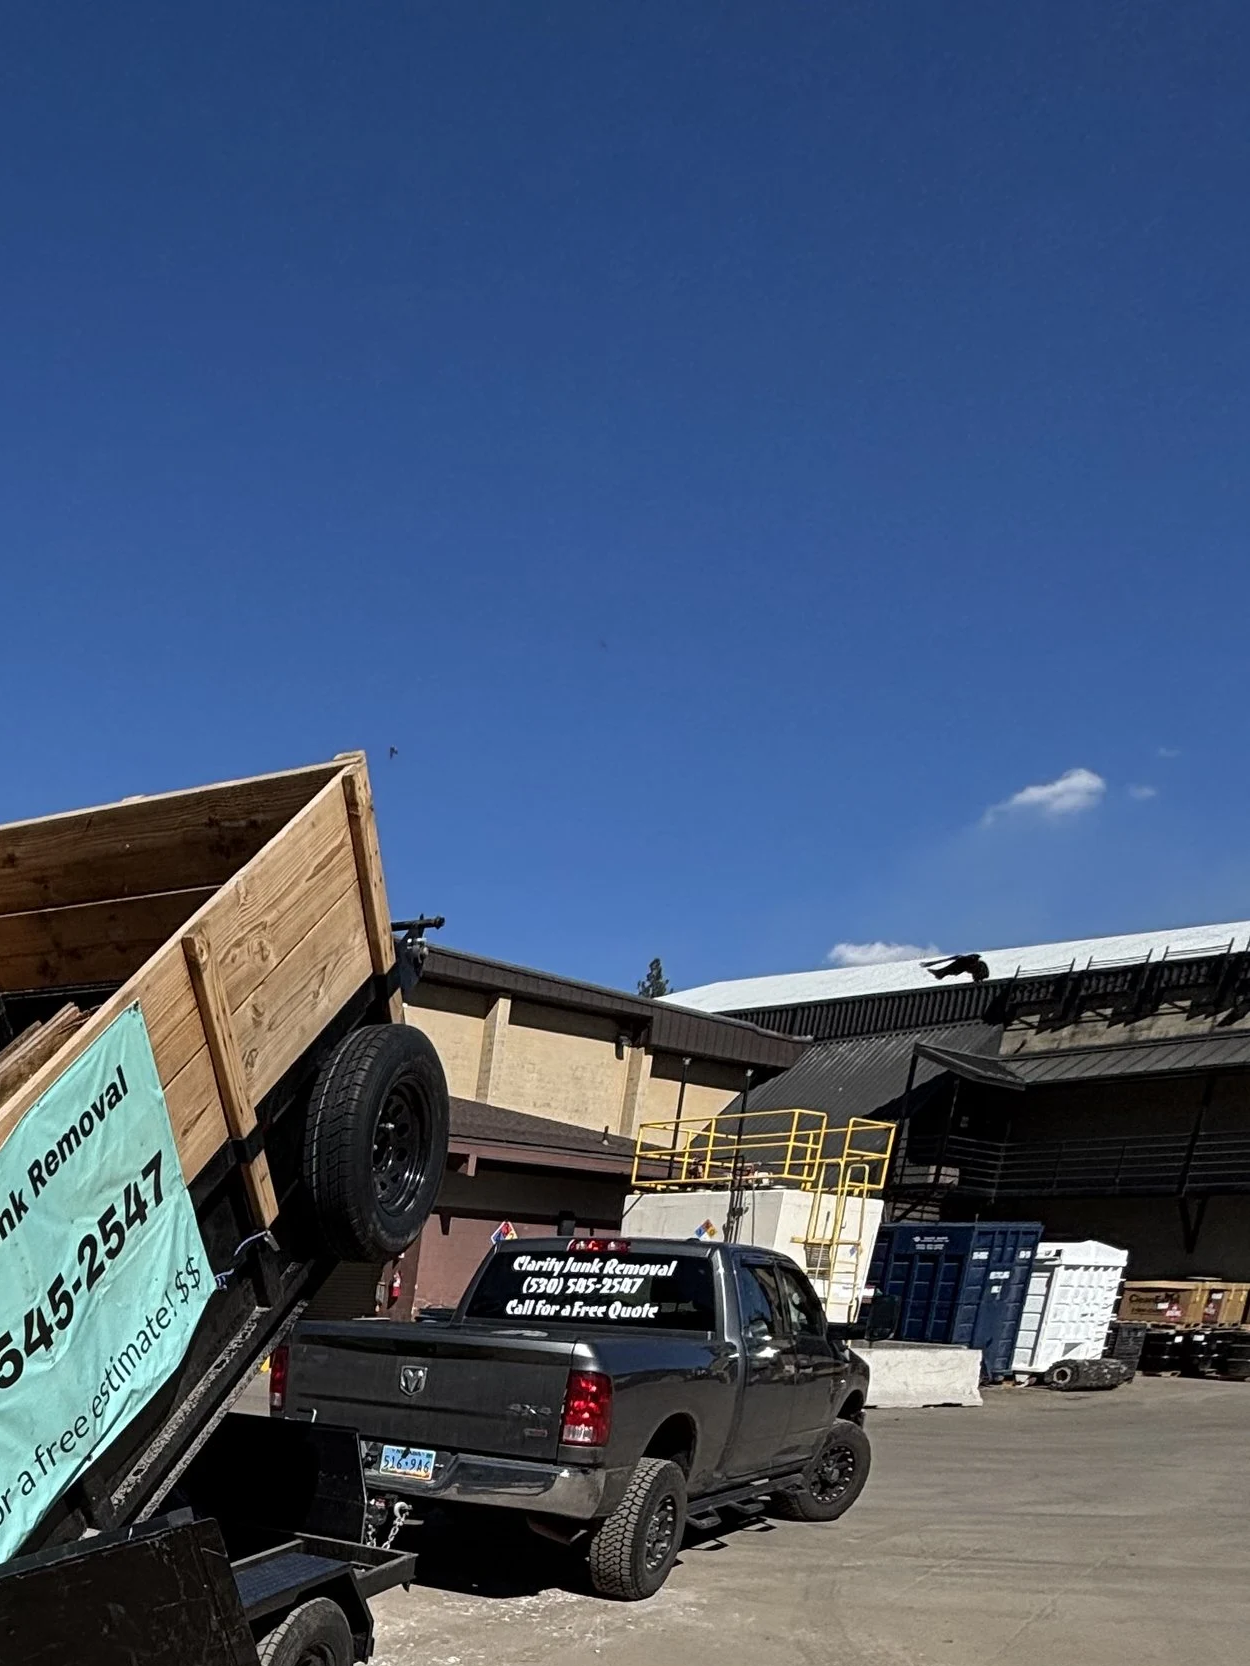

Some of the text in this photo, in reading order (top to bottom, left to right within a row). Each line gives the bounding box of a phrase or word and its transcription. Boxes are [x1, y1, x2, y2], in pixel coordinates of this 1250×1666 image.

[27, 1064, 129, 1198] Removal
[512, 1255, 678, 1277] Clarity Junk Removal
[522, 1276, 645, 1295] (530) 545-2547
[505, 1299, 659, 1319] Call for a Free Quote
[17, 1469, 37, 1496] a
[34, 1414, 90, 1476] free
[91, 1290, 178, 1419] estimate!
[174, 1254, 201, 1305] $$
